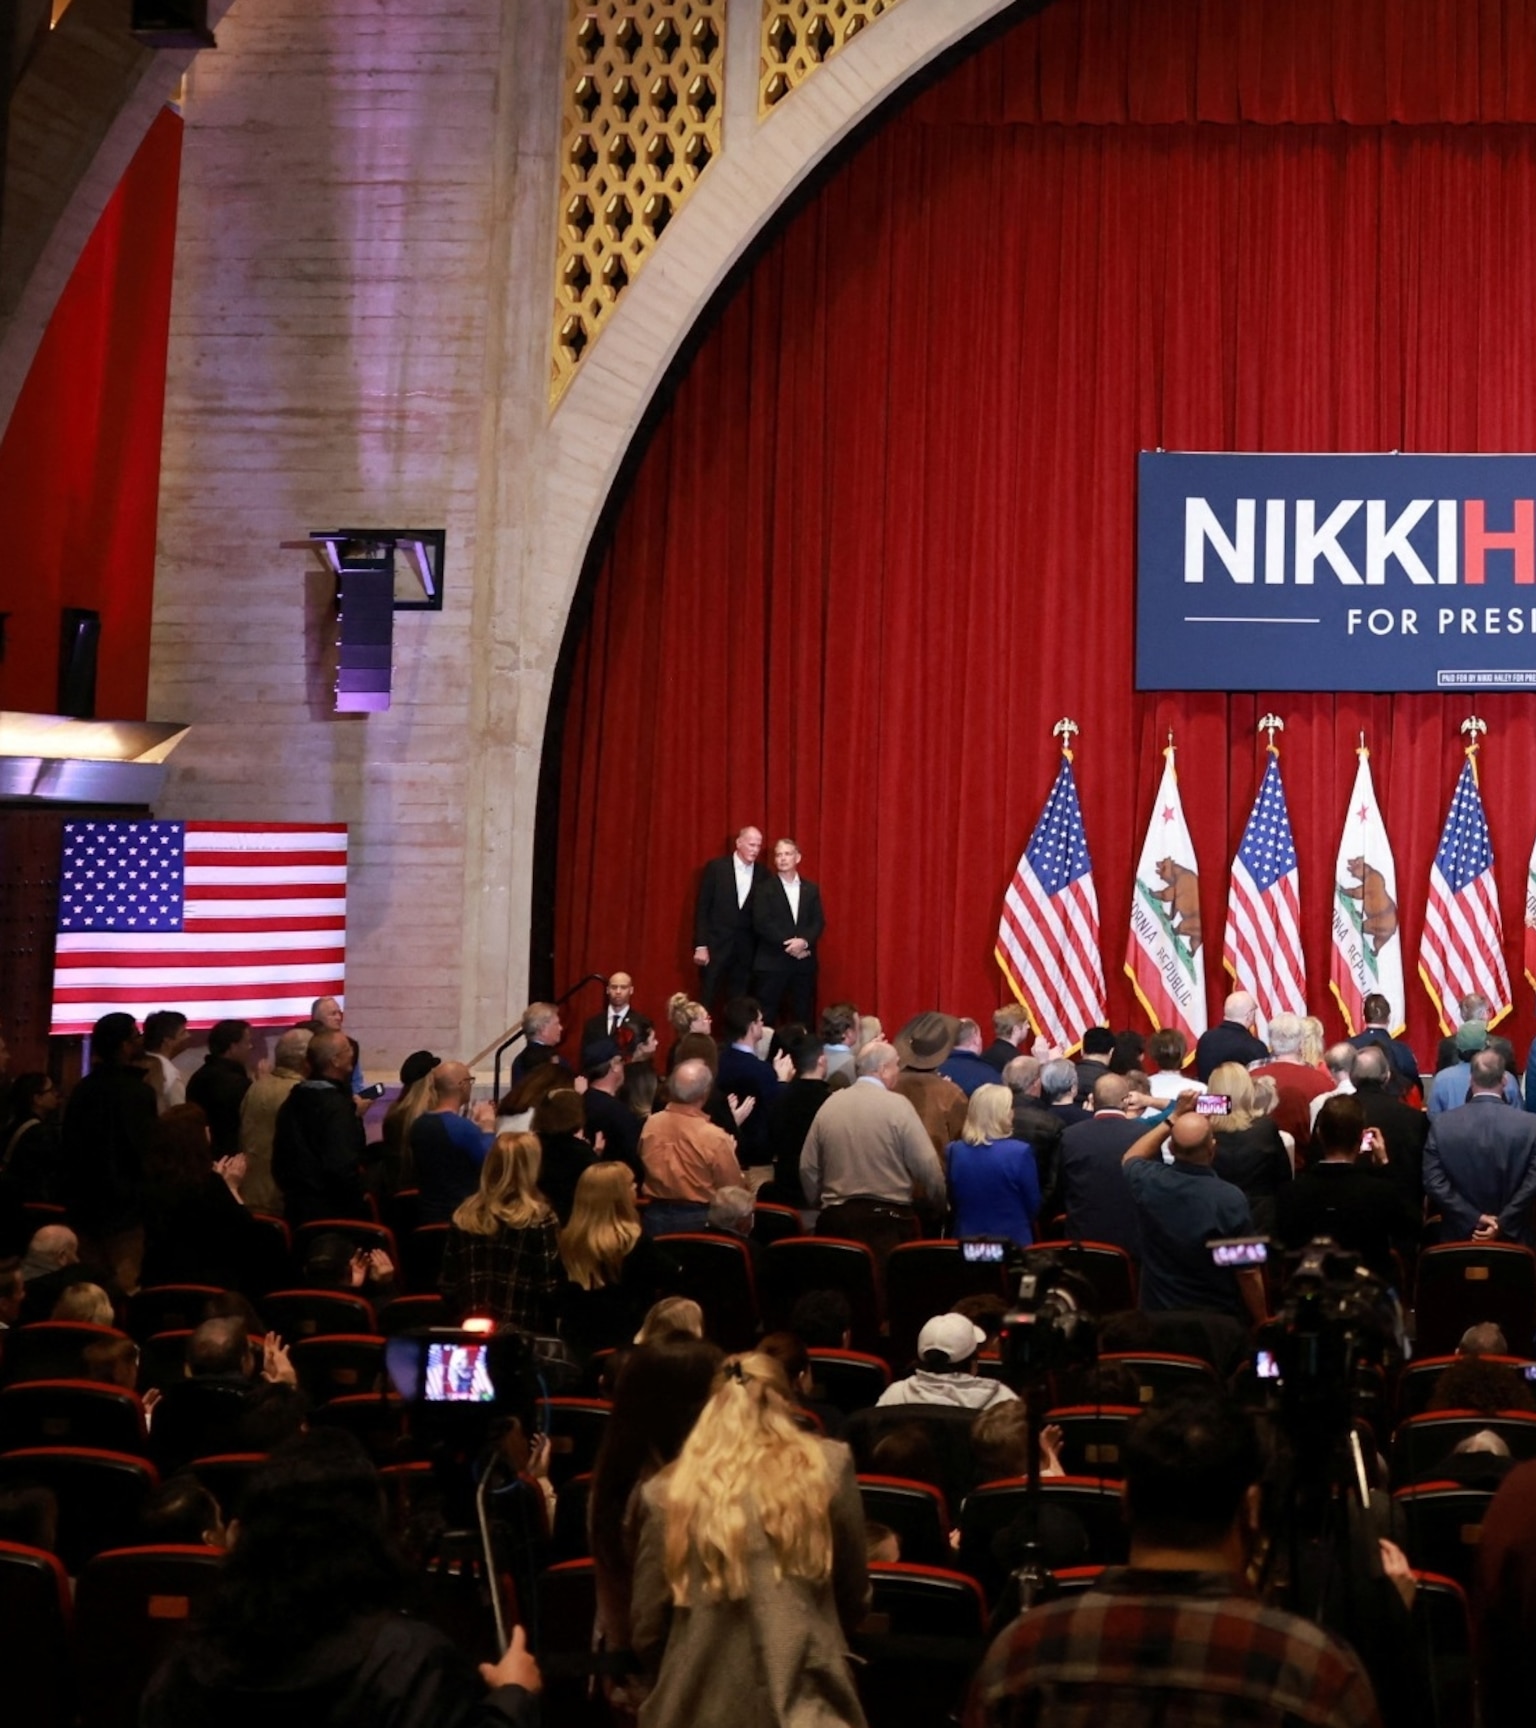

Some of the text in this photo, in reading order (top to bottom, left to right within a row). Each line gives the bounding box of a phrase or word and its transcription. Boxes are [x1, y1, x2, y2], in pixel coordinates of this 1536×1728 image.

[1347, 608, 1419, 636] FOR
[1456, 673, 1468, 682] FOR
[1469, 673, 1477, 682] BY
[1513, 673, 1524, 682] FOR
[1156, 946, 1193, 1007] REPUBLIC
